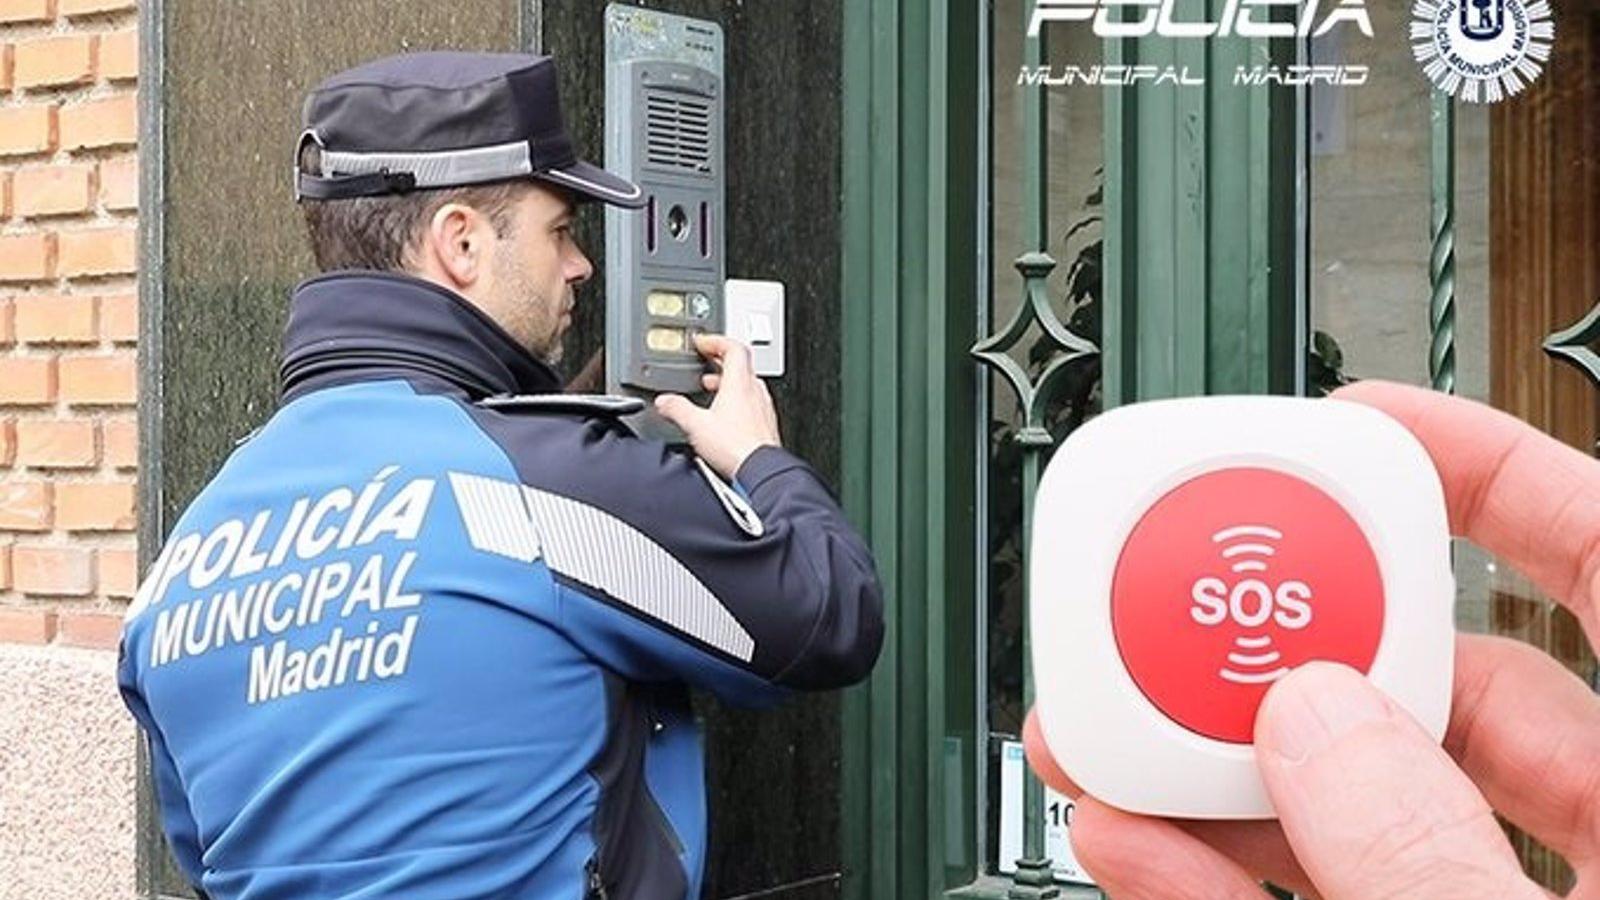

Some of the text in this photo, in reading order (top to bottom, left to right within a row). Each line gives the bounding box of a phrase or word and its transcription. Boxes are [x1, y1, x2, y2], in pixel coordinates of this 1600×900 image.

[151, 466, 436, 605] POLICÍA
[150, 551, 421, 669] MUNICIPAL
[1190, 577, 1313, 630] SOS
[247, 615, 419, 705] Madrid
